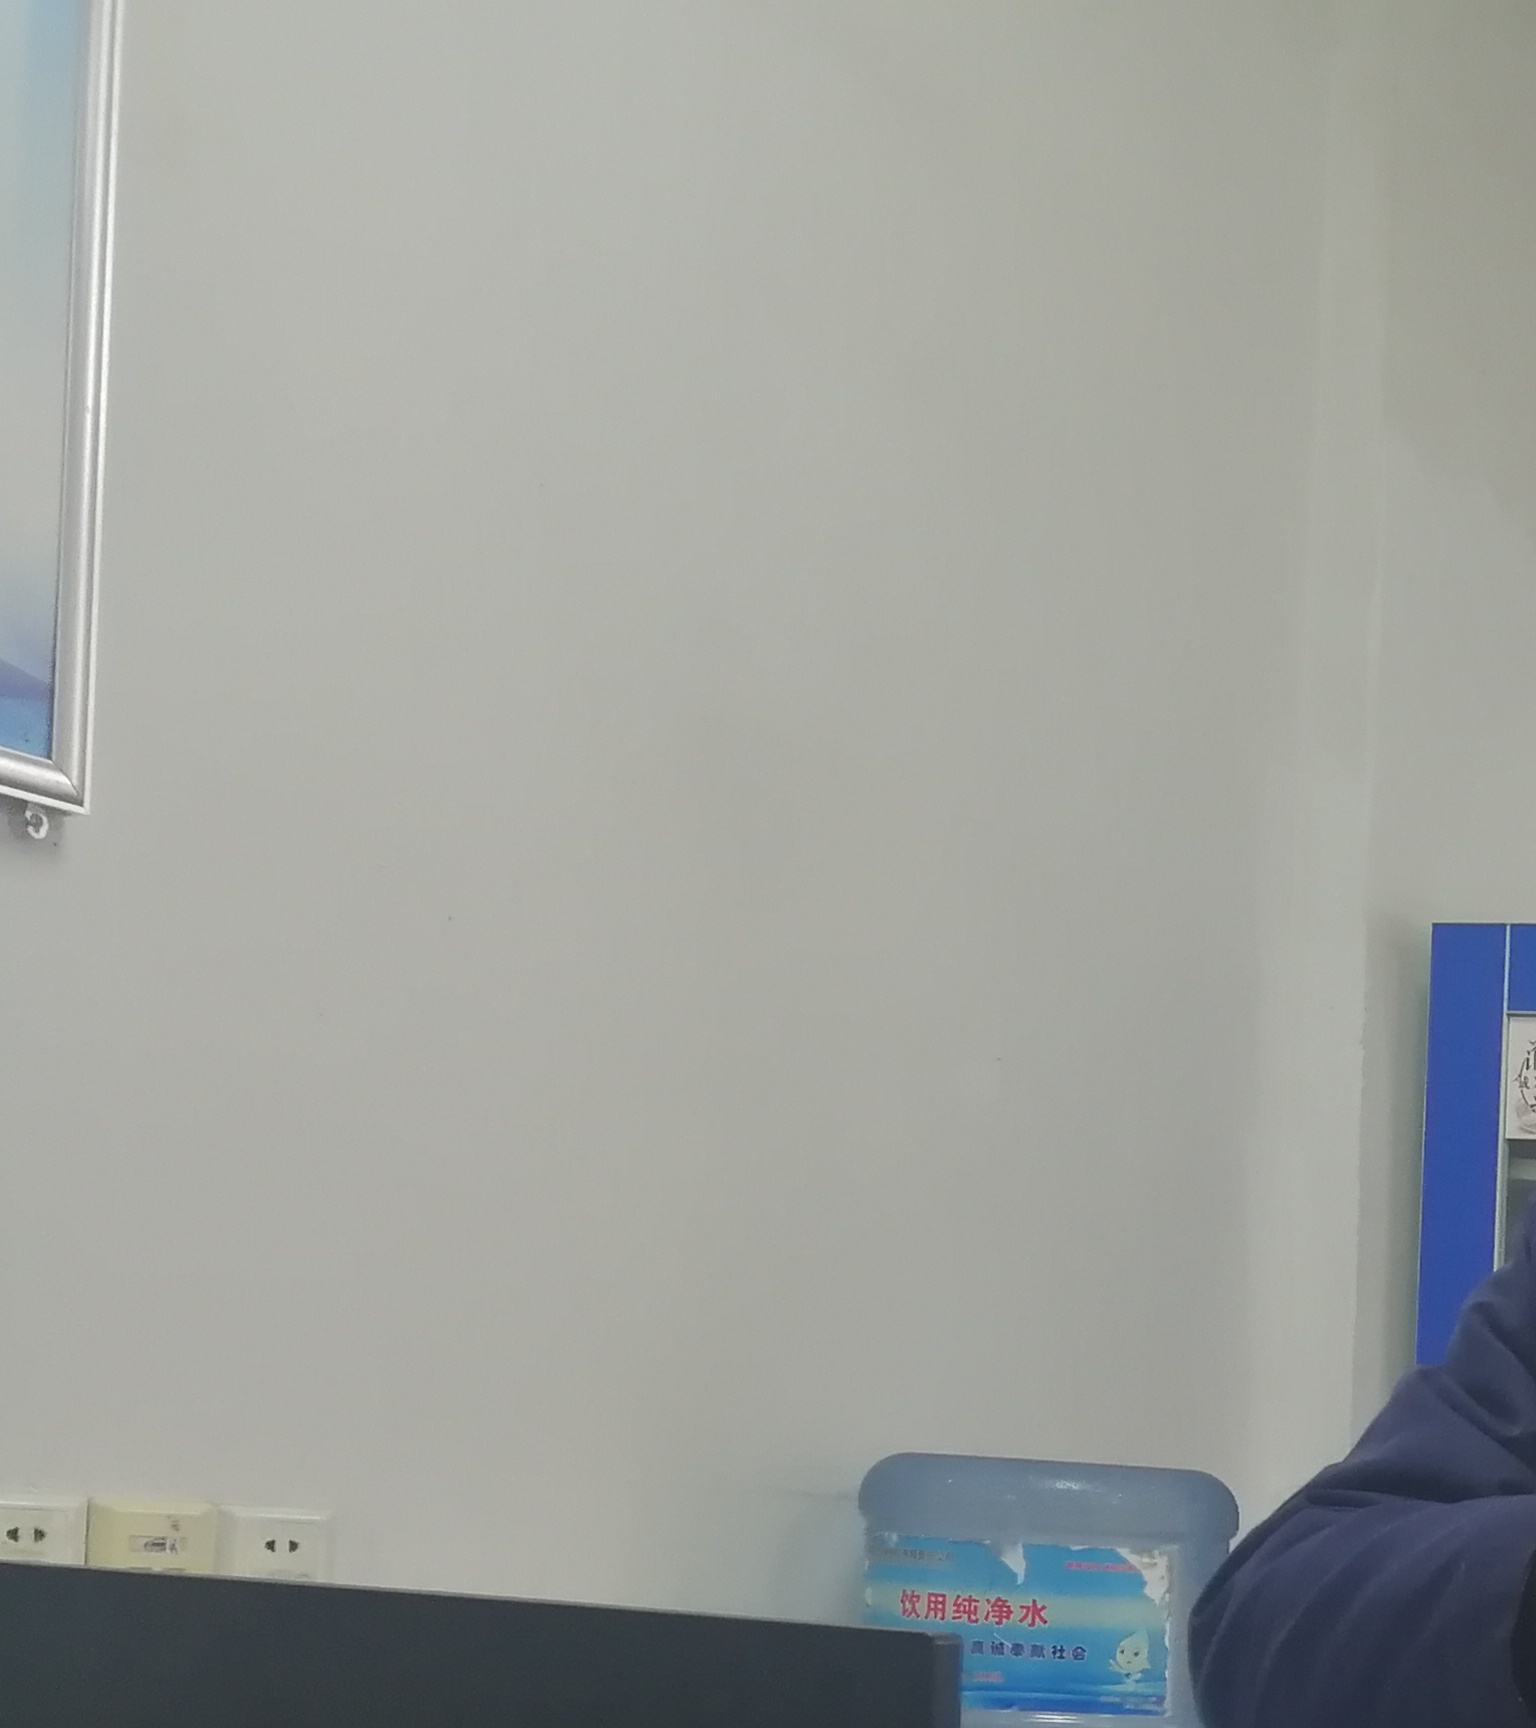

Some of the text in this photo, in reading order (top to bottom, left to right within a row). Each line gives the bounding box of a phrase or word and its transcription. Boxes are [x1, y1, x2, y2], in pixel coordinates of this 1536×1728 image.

[899, 1589, 1049, 1629] 饮用纯净水
